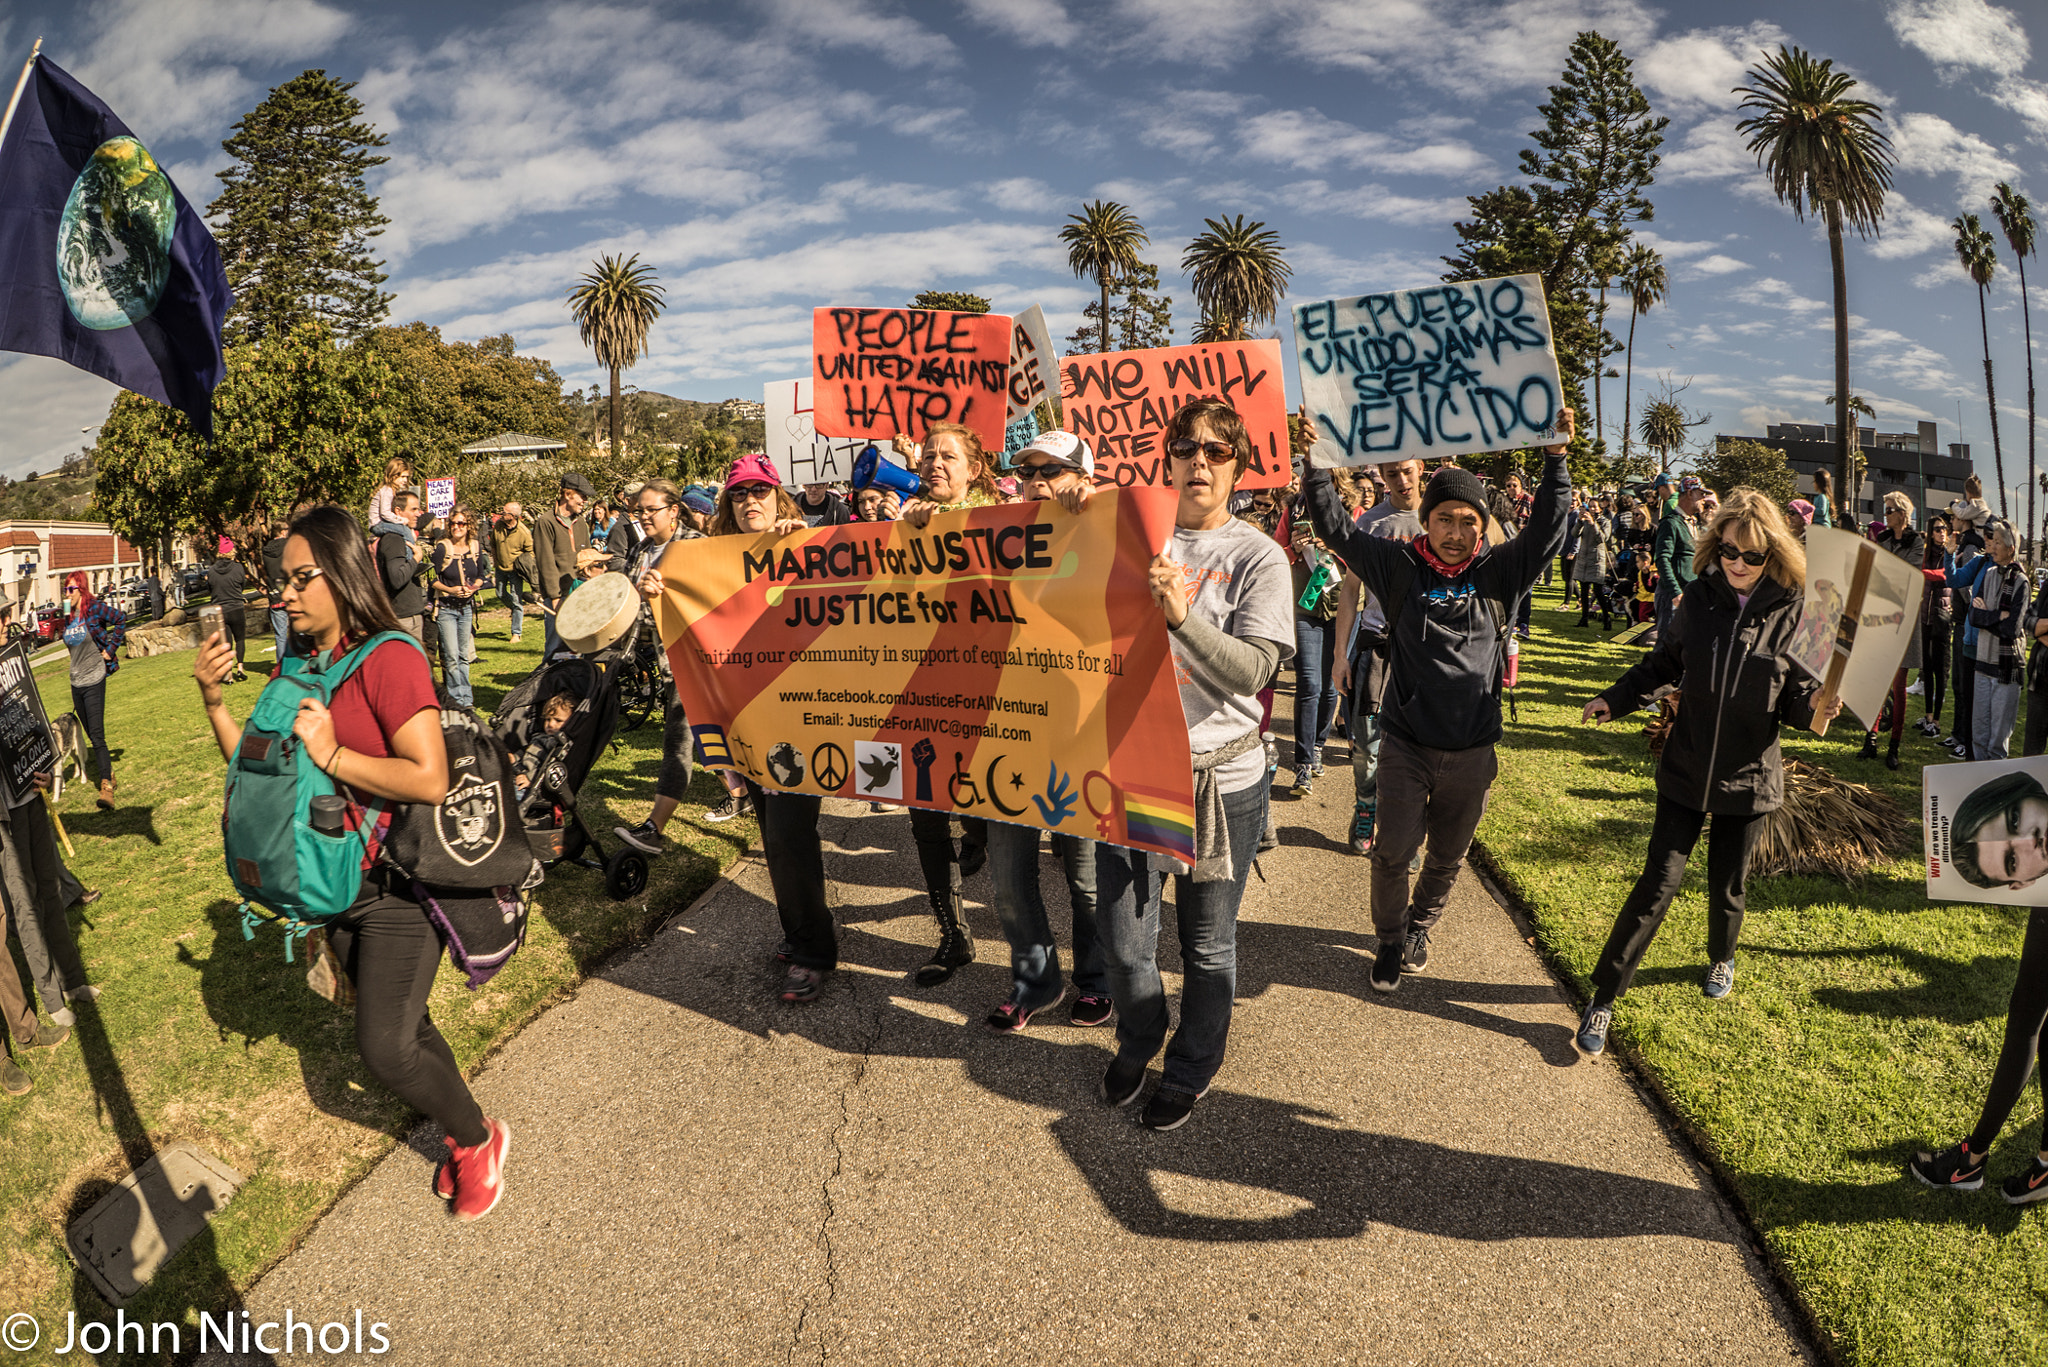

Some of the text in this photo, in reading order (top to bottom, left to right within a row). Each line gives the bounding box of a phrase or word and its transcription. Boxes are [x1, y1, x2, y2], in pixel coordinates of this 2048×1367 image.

[830, 308, 986, 355] PEOPLE
[1303, 315, 1547, 375] UNIDO JAMAS
[818, 353, 1011, 392] UNITED AGAINST
[1016, 422, 1035, 432] MADE
[1071, 401, 1133, 436] NOT
[1318, 376, 1554, 456] VENCIDO
[1017, 432, 1032, 441] YOU
[790, 440, 882, 484] HAT
[427, 479, 453, 488] HEALTH
[430, 487, 450, 496] CARE
[428, 500, 454, 509] HUMAN
[743, 523, 1053, 583] MARCH for JUSTICE
[1196, 567, 1233, 584] Days
[785, 588, 1027, 628] JUSTICE for ALL
[757, 650, 785, 663] our
[789, 645, 880, 666] community
[883, 644, 898, 662] in
[901, 646, 960, 666] support
[964, 645, 978, 664] of
[981, 647, 1024, 669] equal
[1026, 647, 1074, 673] rights
[1077, 650, 1100, 673] for
[1104, 654, 1124, 676] all
[803, 712, 1032, 742] Email: JusticeForAllVC@gmail.com
[13, 755, 28, 776] NO
[28, 736, 48, 761] ONE
[22, 749, 52, 778] WATCHING
[1930, 795, 1939, 829] treated
[1932, 830, 1939, 842] we
[1930, 856, 1941, 878] WHY
